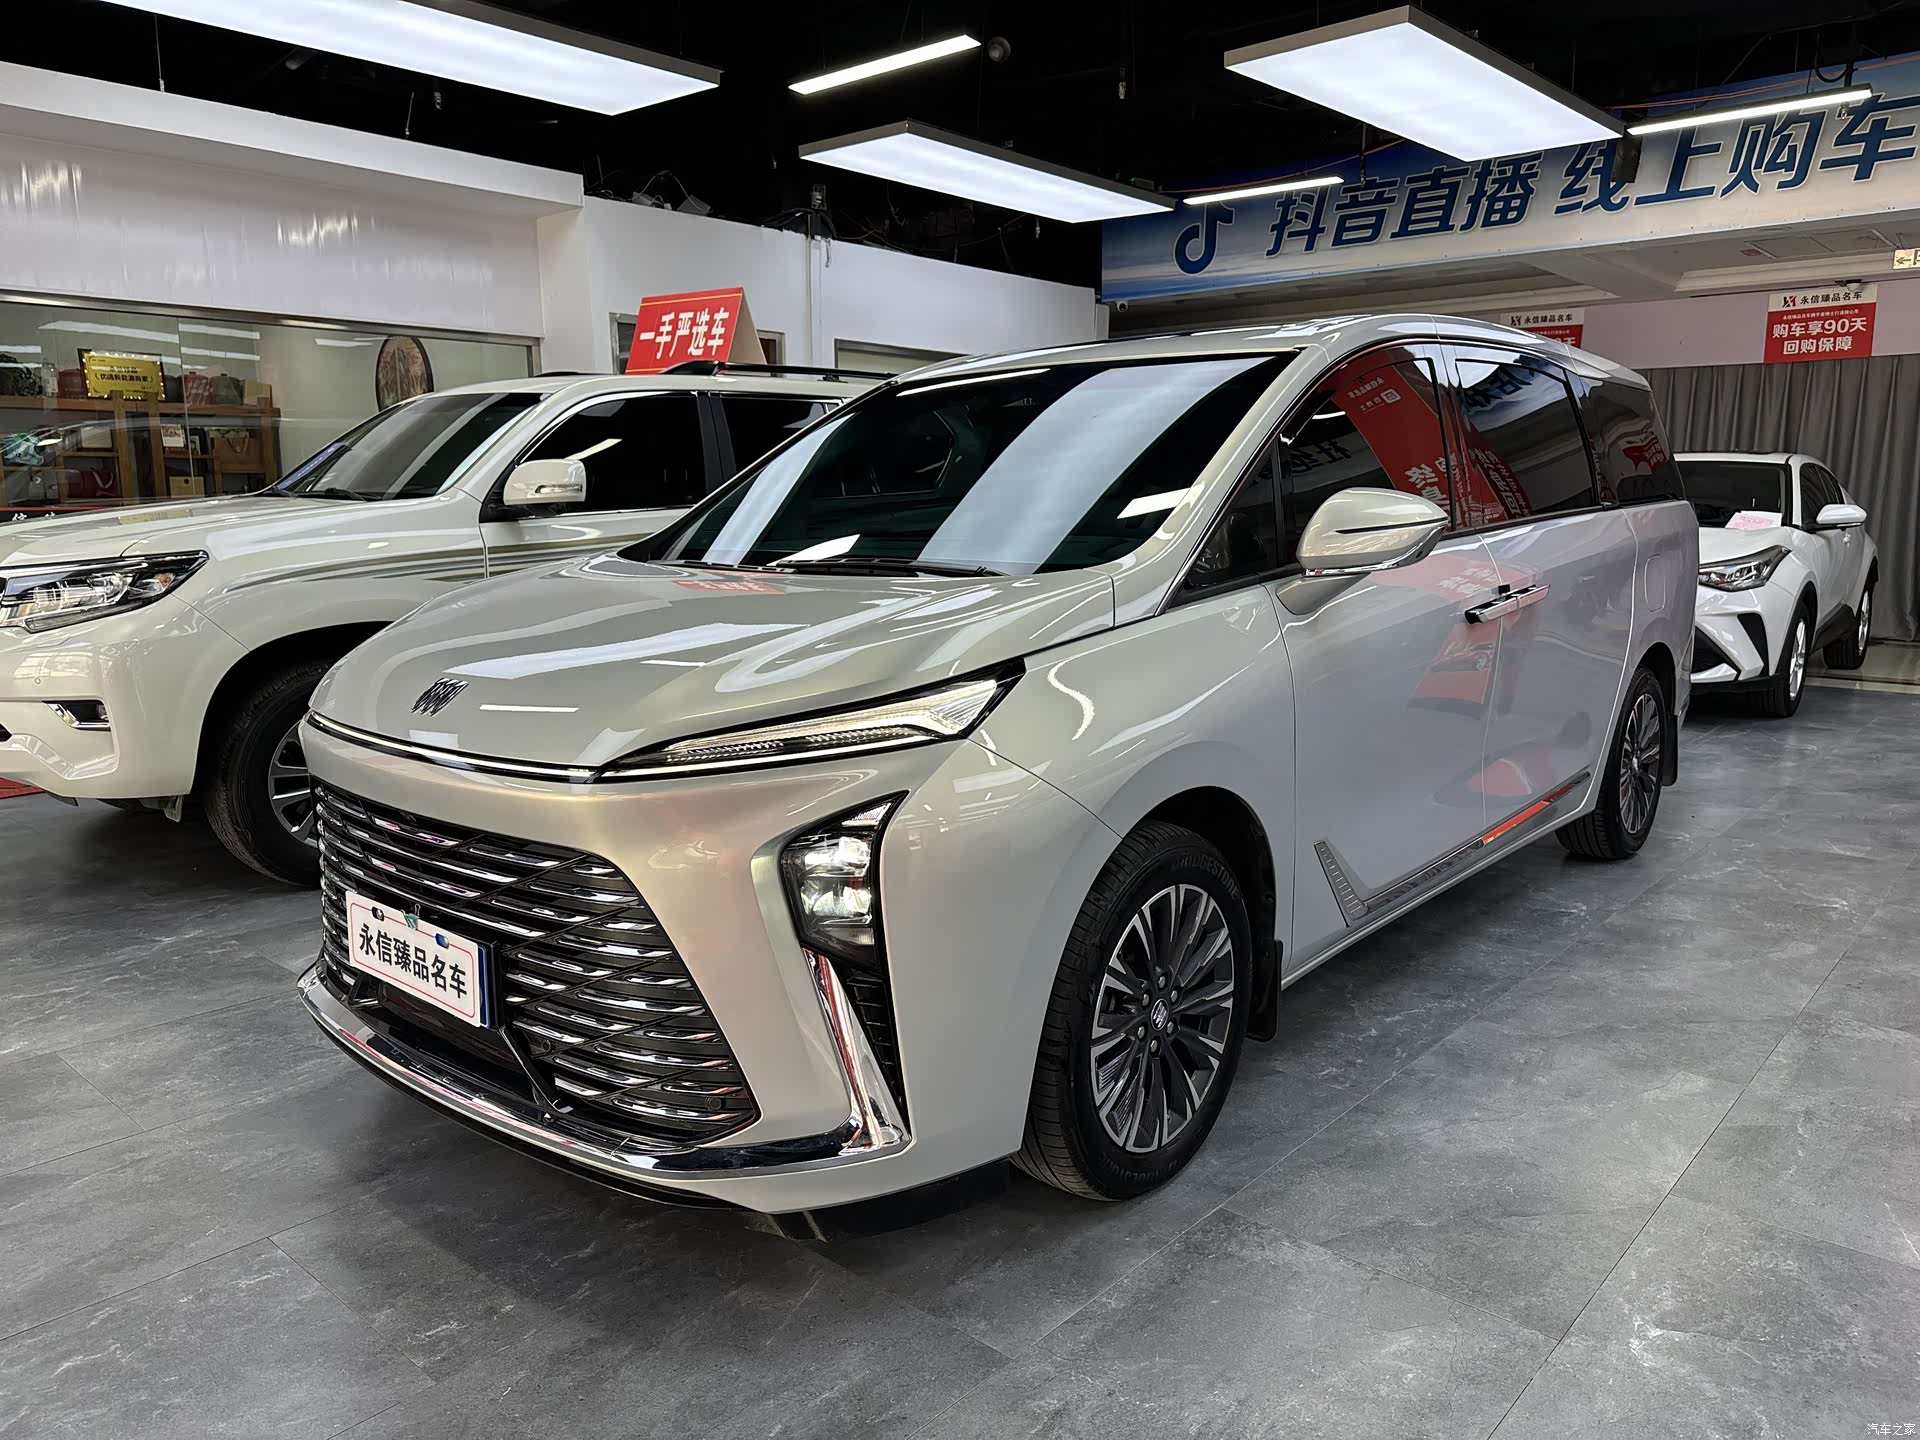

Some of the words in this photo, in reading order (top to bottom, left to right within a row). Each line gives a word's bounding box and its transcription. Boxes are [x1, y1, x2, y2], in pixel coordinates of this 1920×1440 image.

[1265, 151, 1544, 257] 抖音直播
[1553, 93, 1920, 215] 线上购车
[1800, 291, 1862, 305] 永信臻品名车
[640, 306, 729, 360] 一手严选车
[1772, 317, 1867, 338] 购车享90天
[1783, 336, 1853, 355] 回购保障
[359, 923, 467, 999] 永信臻品名车
